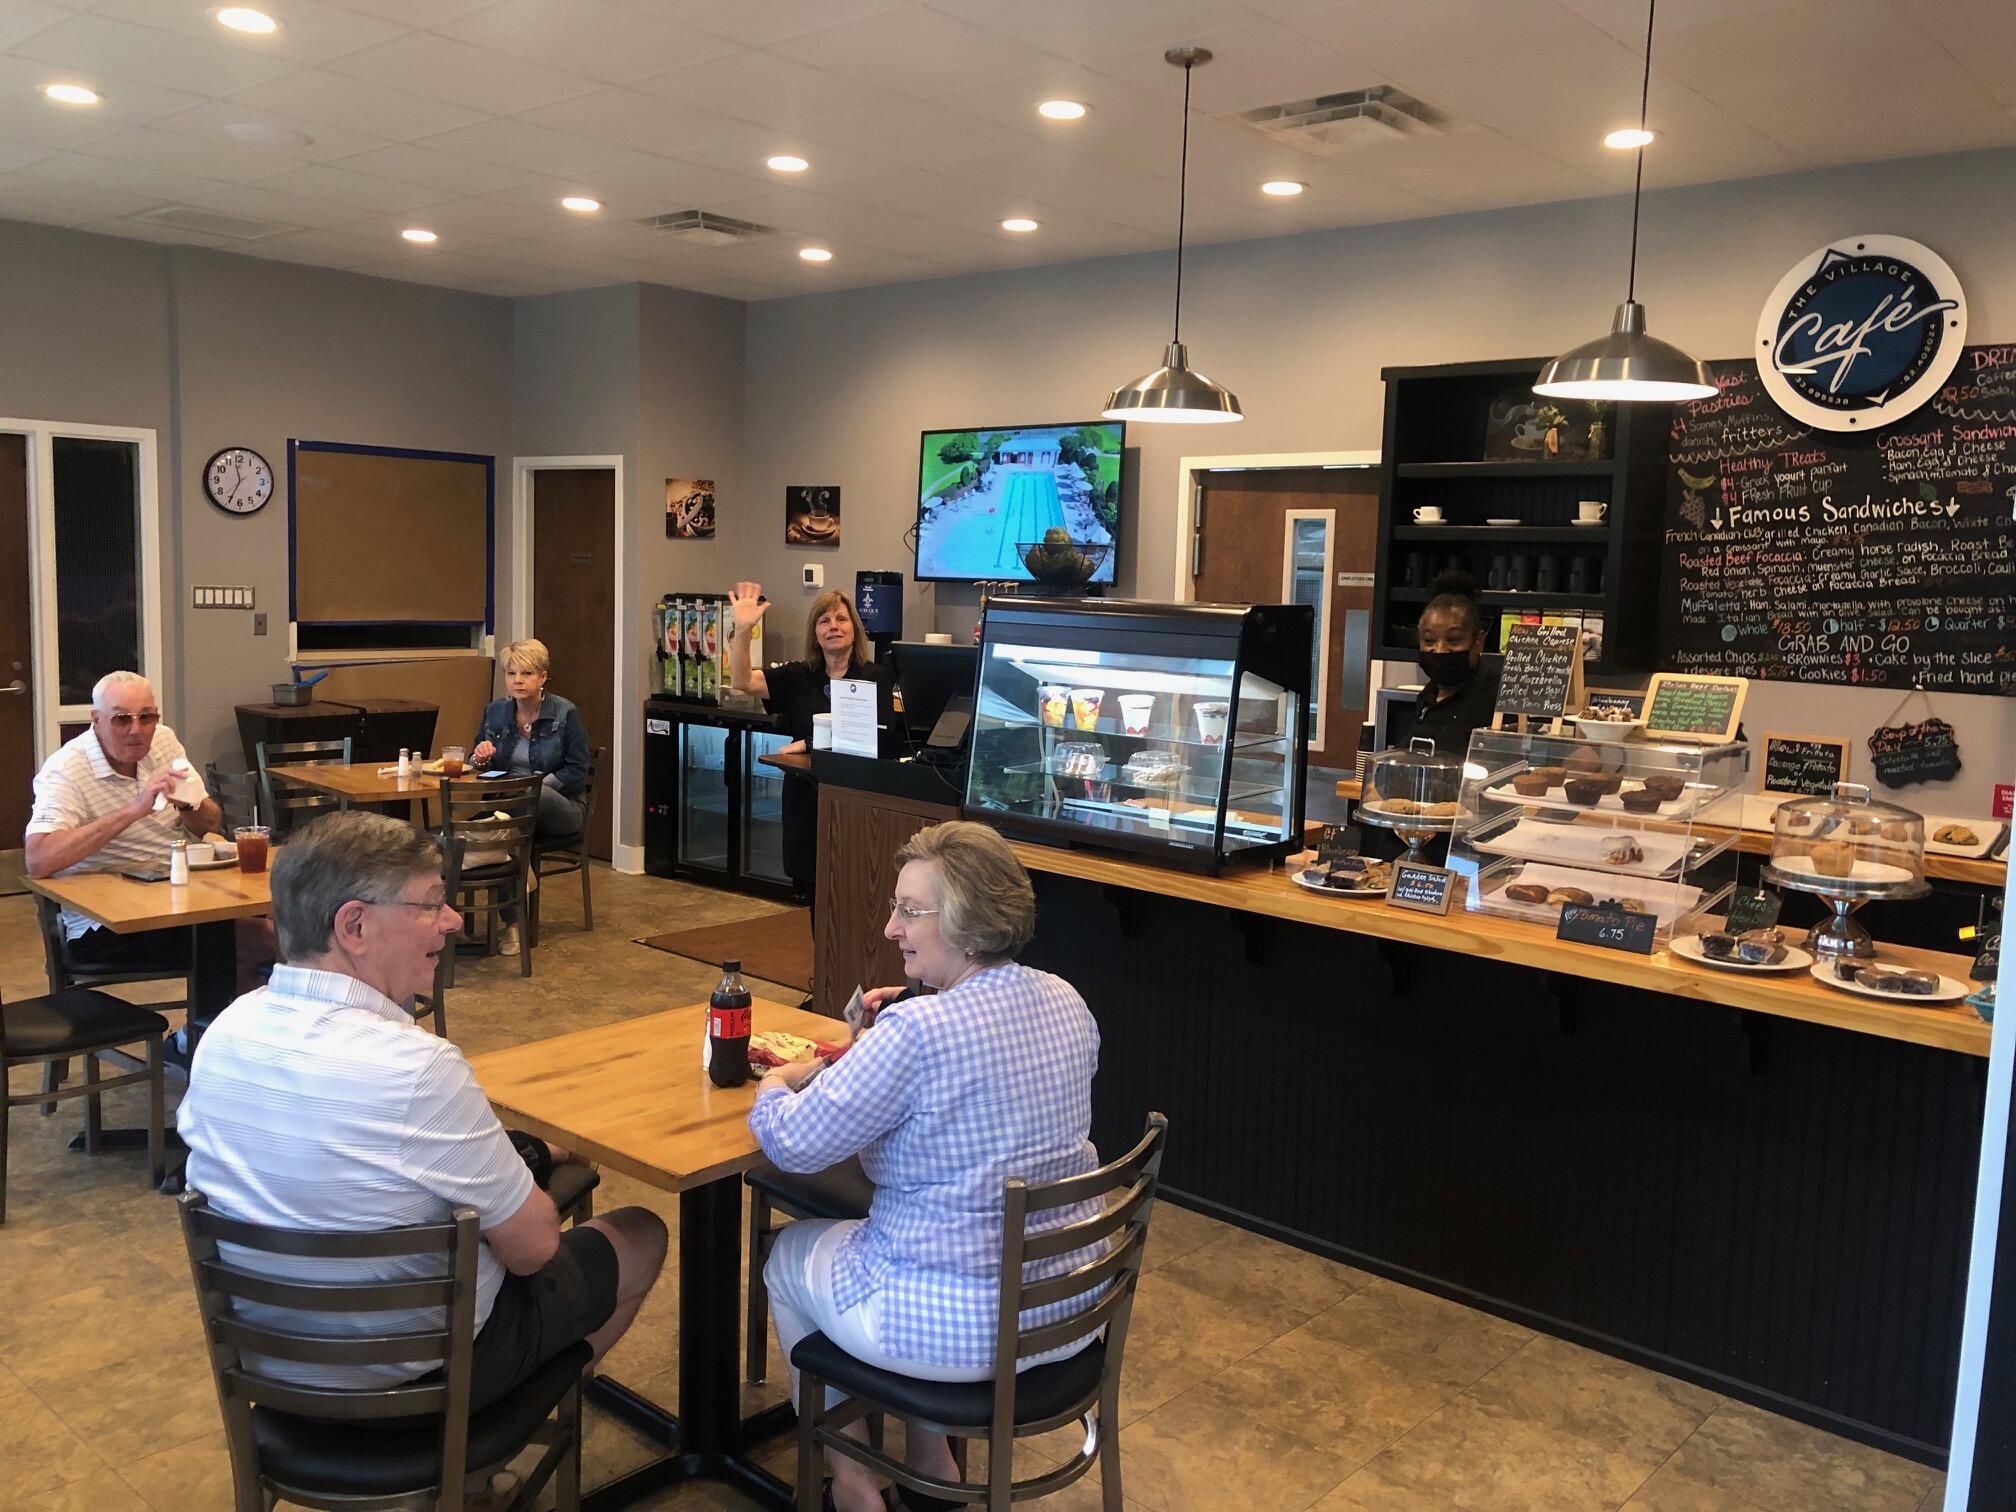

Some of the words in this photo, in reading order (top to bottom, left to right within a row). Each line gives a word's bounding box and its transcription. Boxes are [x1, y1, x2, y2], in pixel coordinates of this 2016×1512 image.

[1788, 284, 1817, 319] THE
[1824, 261, 1912, 289] VILLAGE
[1689, 393, 1753, 418] Pastries
[1721, 426, 1784, 444] fritters
[1952, 424, 2016, 441] Sandwich
[1962, 440, 2007, 456] Cheese
[1728, 504, 1812, 528] Famous
[1821, 494, 1944, 524] Sandwiches
[1665, 528, 1699, 545] French
[1713, 543, 1721, 553] a
[1776, 536, 1797, 548] with
[1680, 552, 1724, 570] Roasted
[1725, 549, 1751, 567] Beef
[1860, 543, 1893, 557] horse
[1951, 537, 1991, 552] Roast
[1701, 565, 1721, 578] Red
[1901, 553, 1917, 565] on
[1970, 548, 2009, 562] Bread
[1925, 604, 1942, 616] be
[1536, 625, 1568, 637] Grilled
[1840, 615, 1869, 632] half
[1944, 616, 1992, 632] Quarter
[1777, 634, 1832, 655] GRAB
[1840, 633, 1875, 655] AND
[1880, 633, 1912, 654] GO
[1724, 649, 1757, 667] Chips
[1874, 651, 1909, 667] Cake
[1912, 652, 1932, 671] by
[1934, 652, 1957, 666] the
[1798, 664, 1848, 682] Cookies
[1959, 668, 1996, 685] hand
[1881, 727, 1908, 743] Soup
[1598, 927, 1625, 941] 6.75
